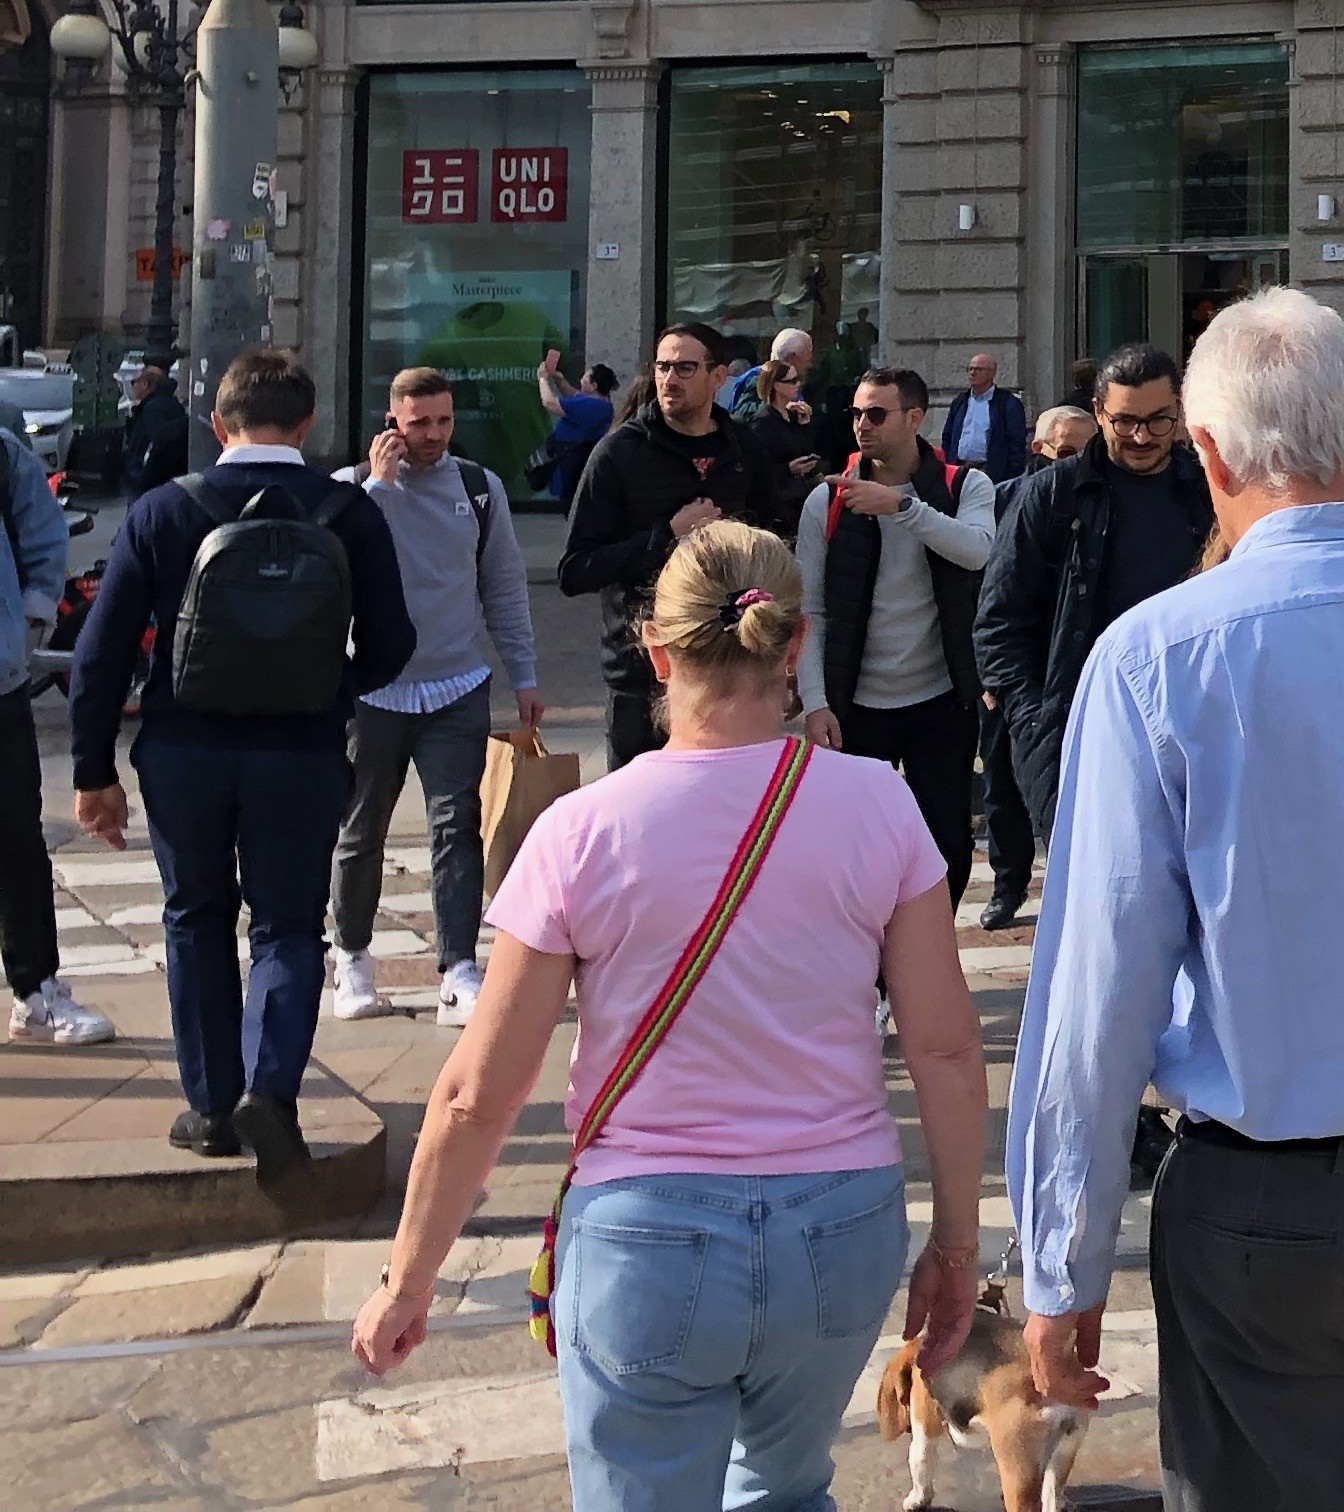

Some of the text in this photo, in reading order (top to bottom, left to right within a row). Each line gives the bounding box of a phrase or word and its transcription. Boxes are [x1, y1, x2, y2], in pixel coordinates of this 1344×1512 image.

[500, 157, 550, 182] UNI
[499, 188, 555, 217] QLO
[451, 283, 523, 299] Masterpiece
